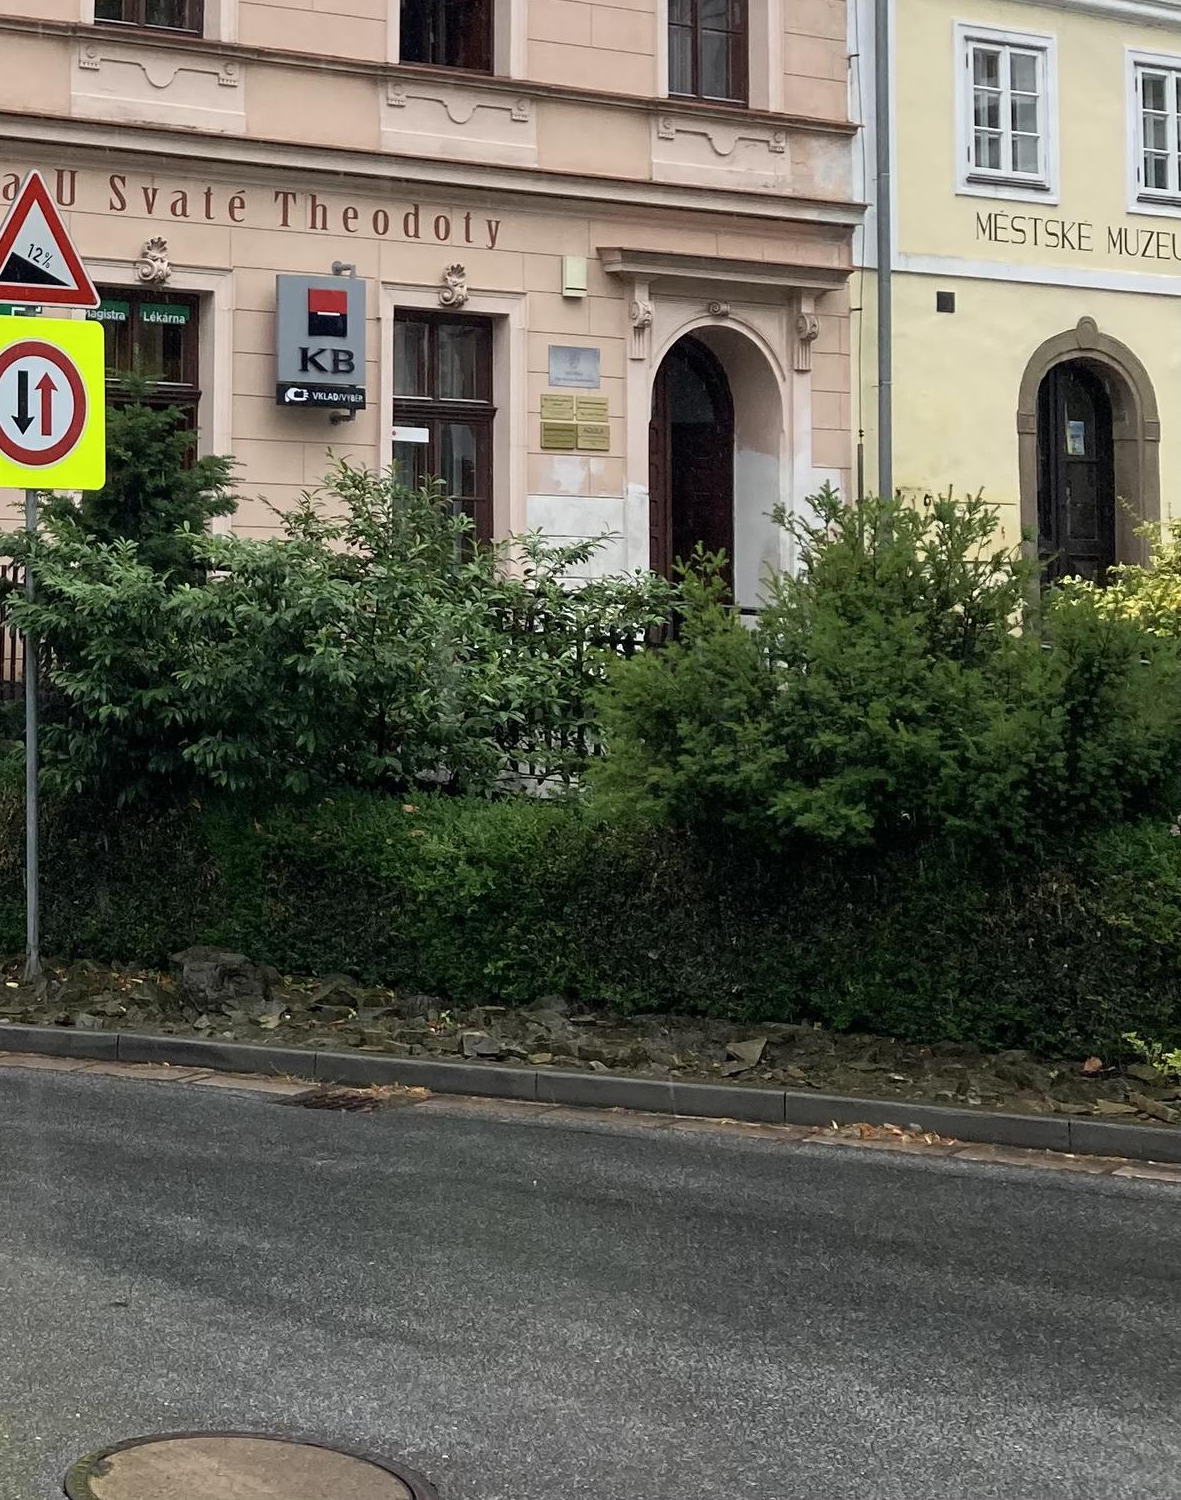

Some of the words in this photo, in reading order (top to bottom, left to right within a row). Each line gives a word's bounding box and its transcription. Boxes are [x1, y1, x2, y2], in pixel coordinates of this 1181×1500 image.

[54, 168, 79, 206] U
[109, 174, 247, 223] Svaté
[274, 190, 501, 249] Theodoty
[28, 243, 54, 269] 12%
[143, 311, 186, 324] Lékárna
[298, 346, 355, 374] KB
